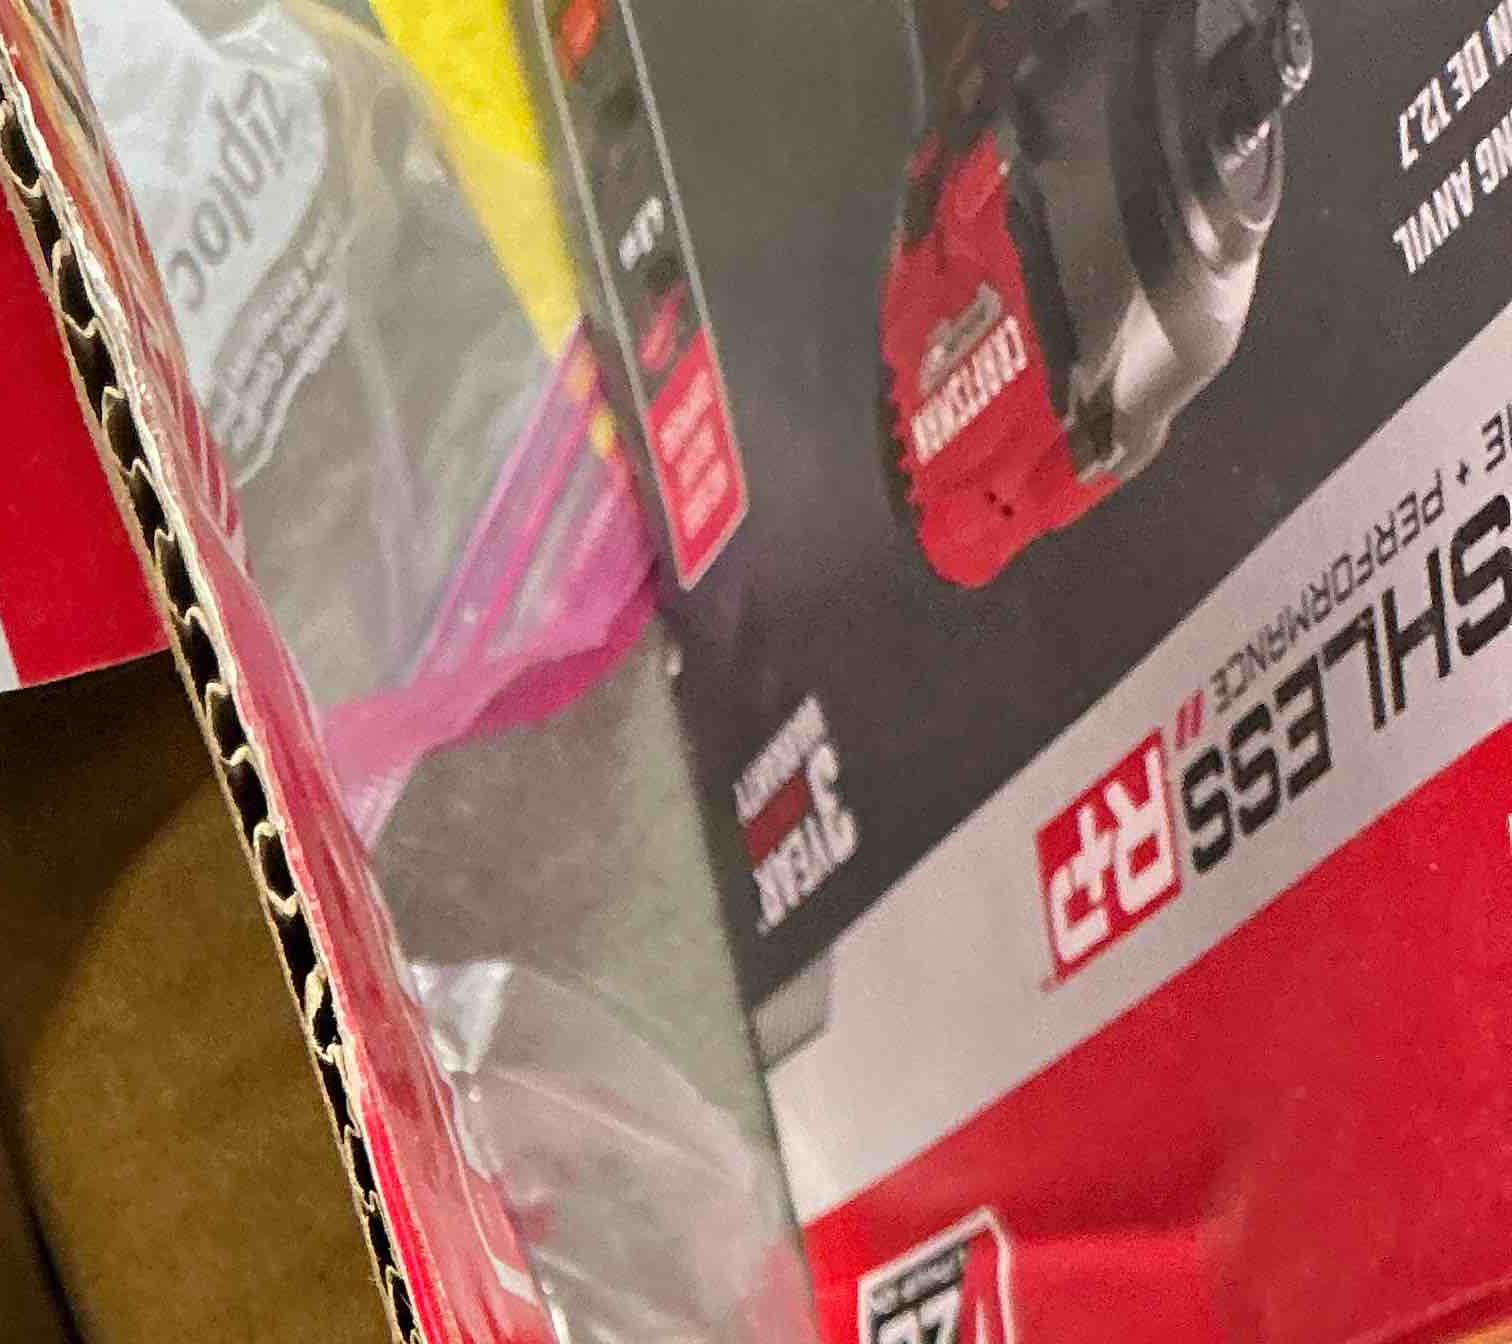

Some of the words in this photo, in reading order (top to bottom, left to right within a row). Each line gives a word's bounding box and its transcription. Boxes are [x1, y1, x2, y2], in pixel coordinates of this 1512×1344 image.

[1446, 31, 1489, 110] DE
[1392, 159, 1474, 274] ANVIL
[1210, 466, 1446, 714] PERFORMANCE
[1181, 494, 1512, 874] SHLESS
